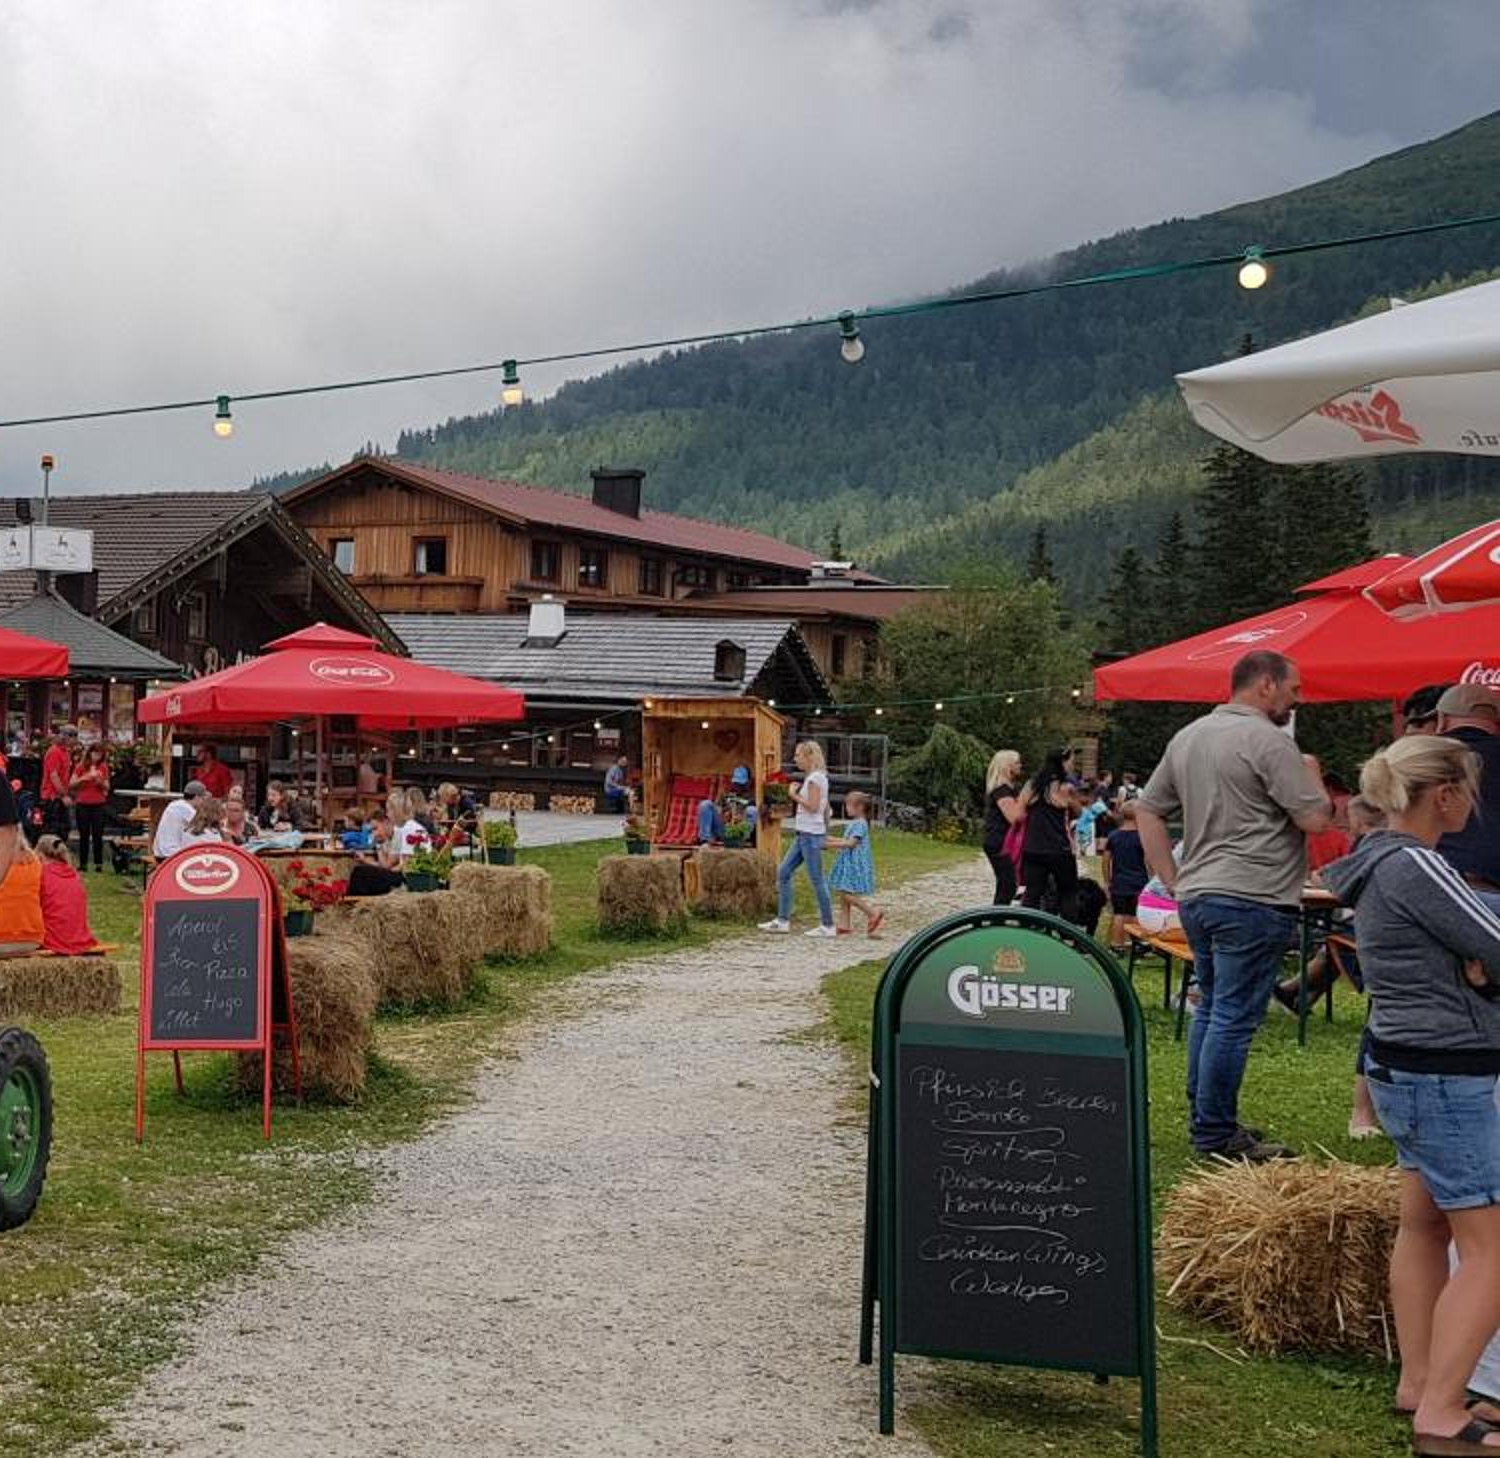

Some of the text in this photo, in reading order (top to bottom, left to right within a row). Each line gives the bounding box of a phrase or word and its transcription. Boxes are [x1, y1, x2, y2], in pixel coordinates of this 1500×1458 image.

[203, 960, 248, 980] Pizza
[947, 964, 1073, 1017] Gösser
[202, 991, 244, 1019] Hugo
